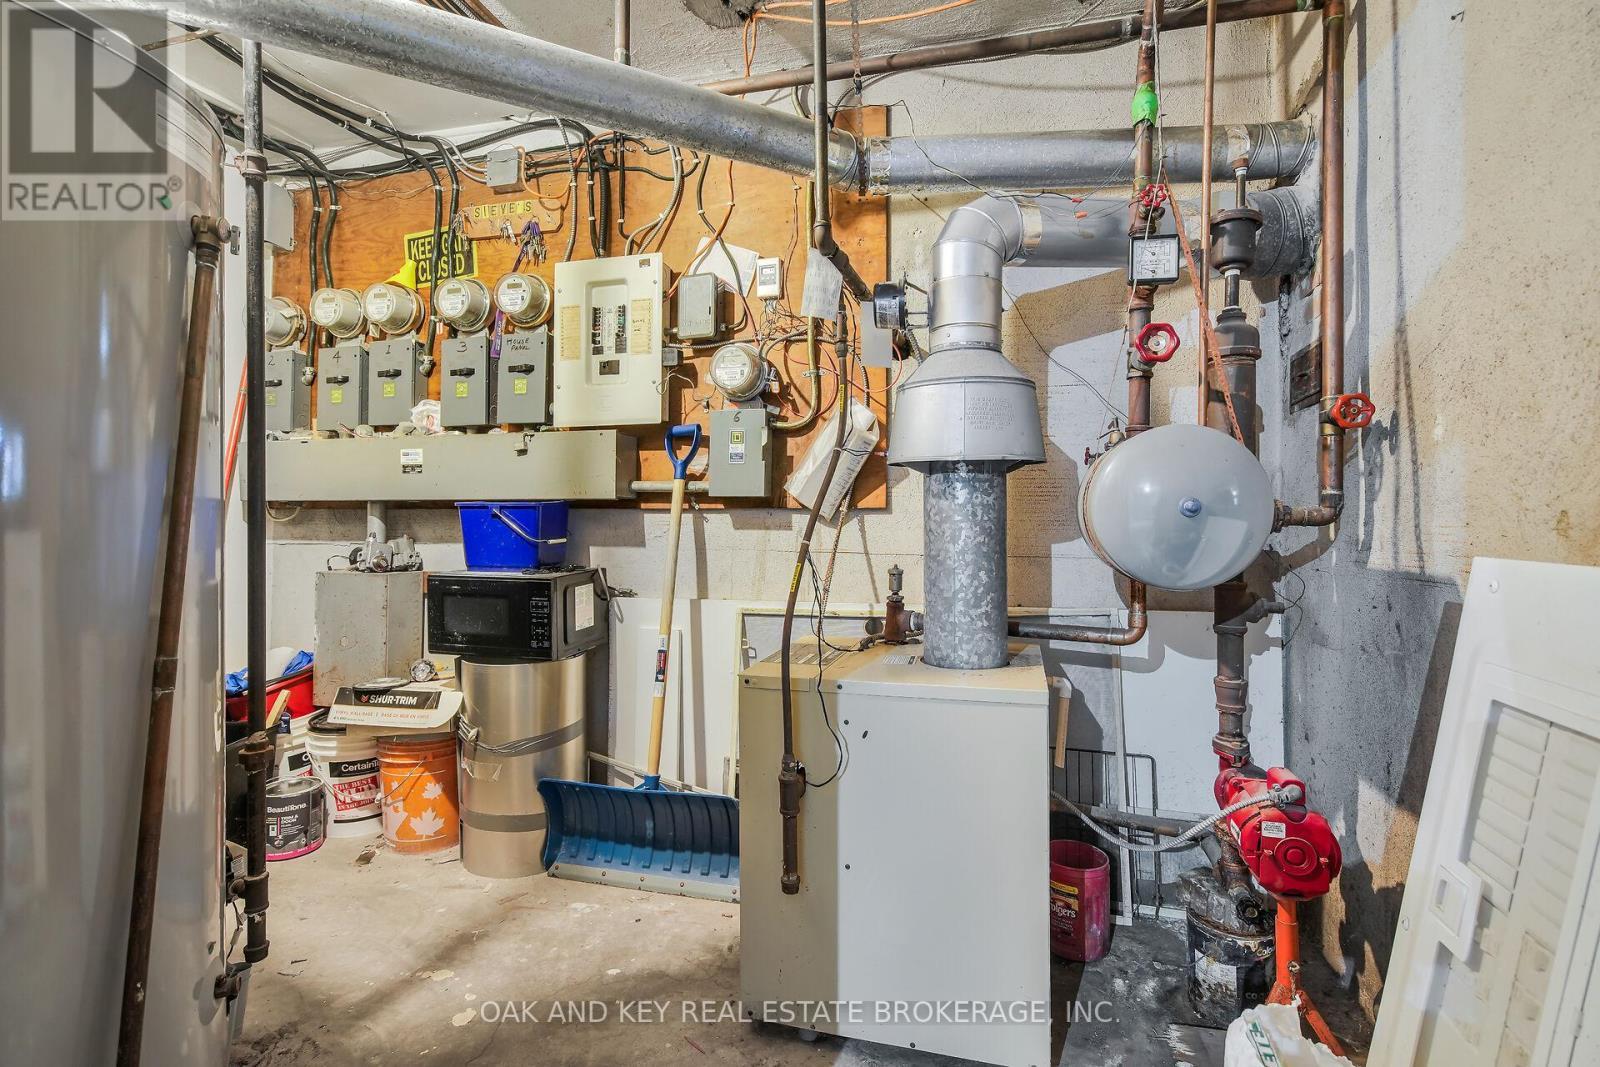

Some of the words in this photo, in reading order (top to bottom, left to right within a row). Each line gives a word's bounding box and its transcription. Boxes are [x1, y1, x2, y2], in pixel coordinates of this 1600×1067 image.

[456, 342, 467, 352] 3
[332, 351, 341, 363] 4
[733, 411, 740, 422] 6
[369, 694, 418, 706] SHUR-TRIM
[266, 803, 307, 814] BeautiTone
[1050, 902, 1076, 918] olgers
